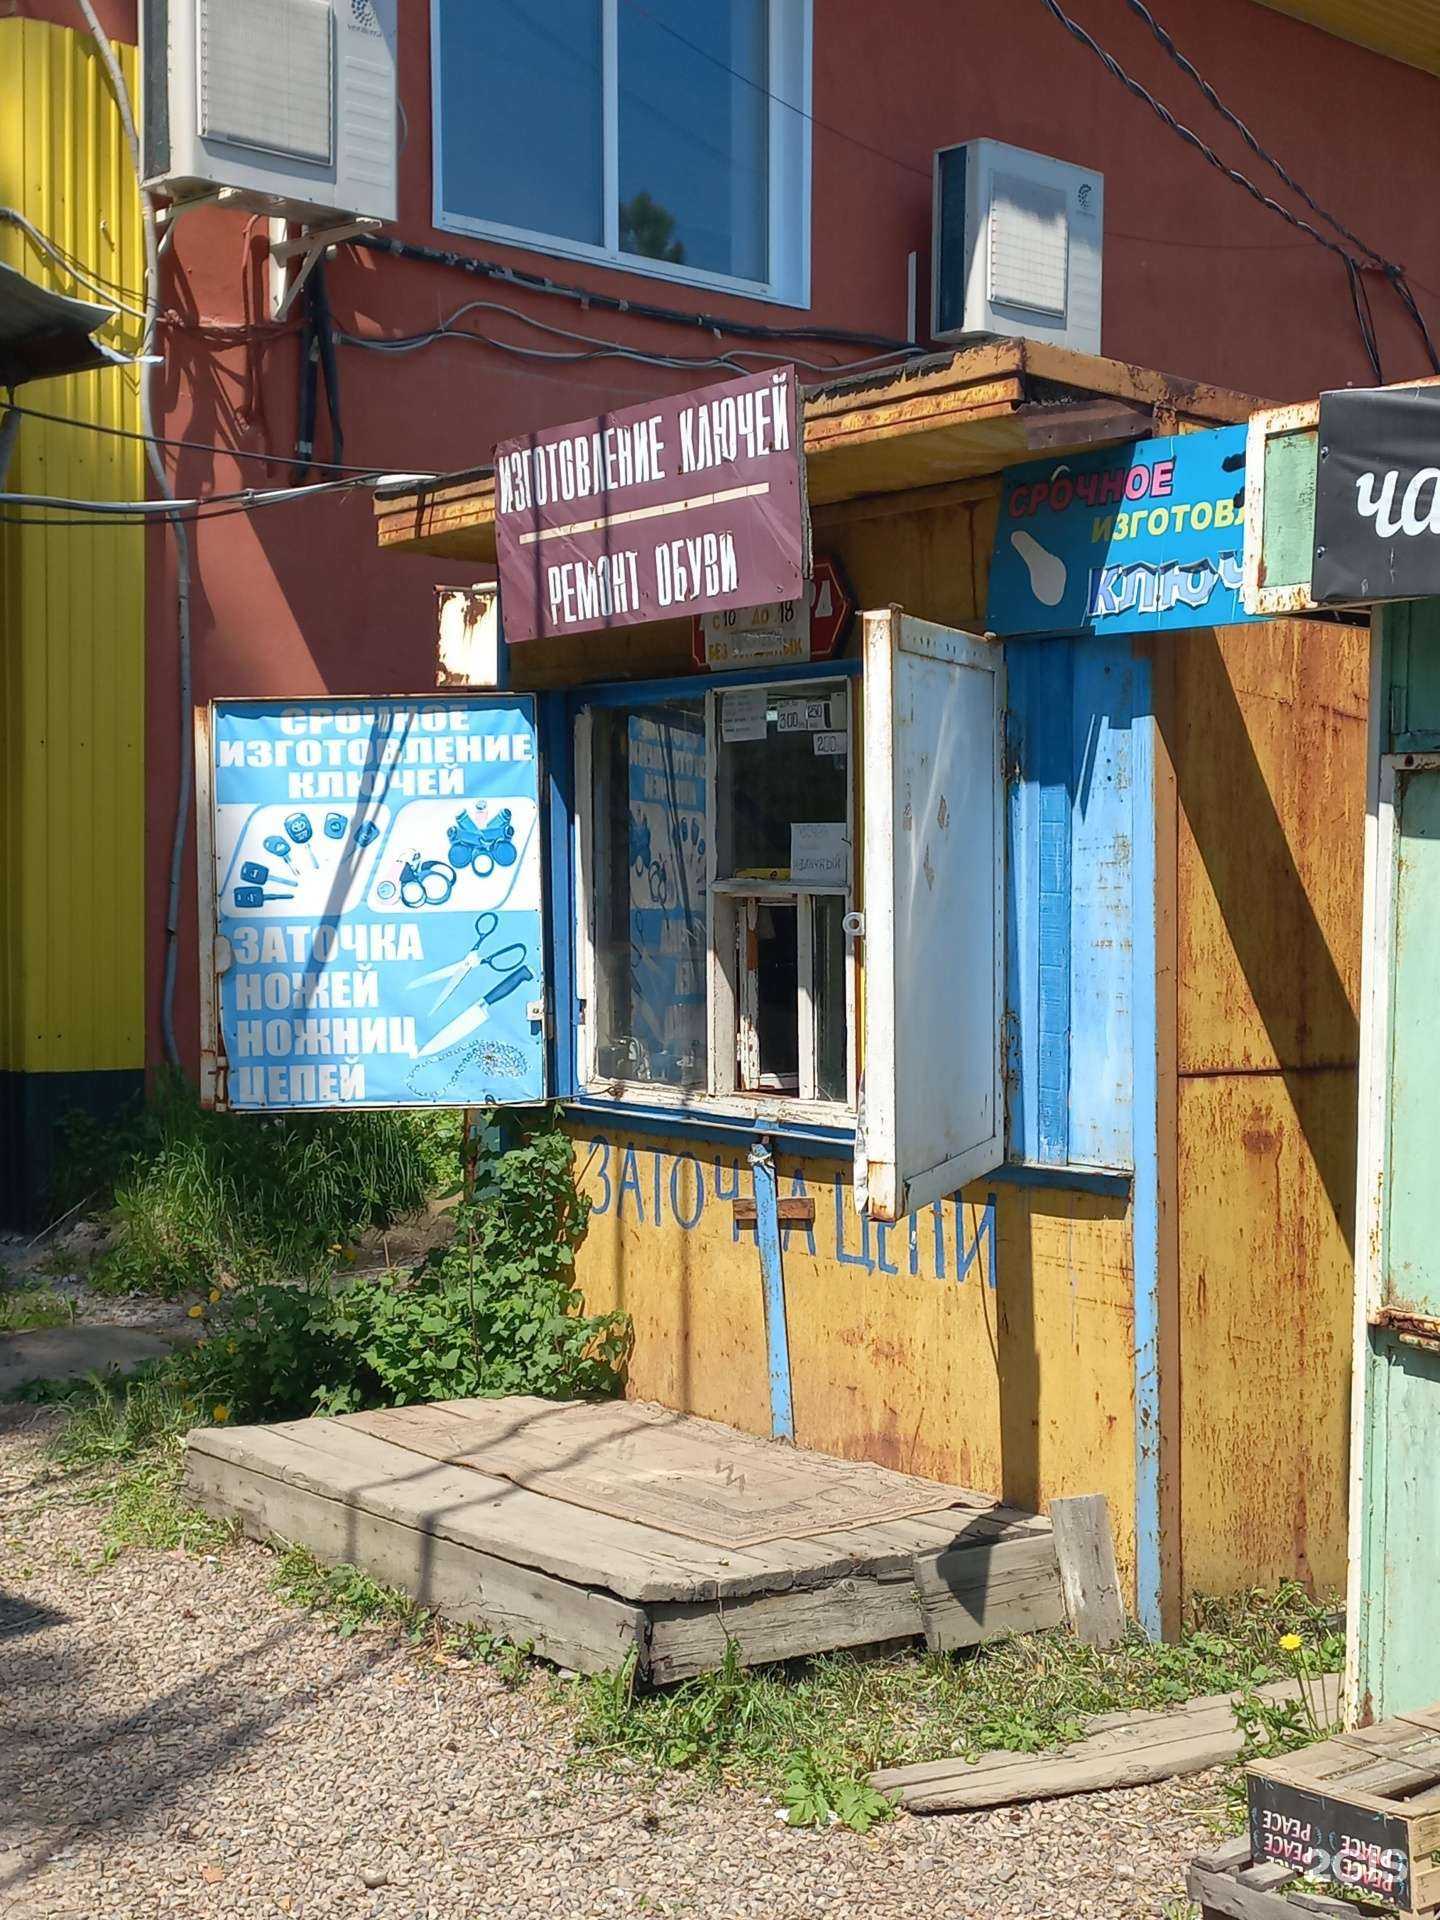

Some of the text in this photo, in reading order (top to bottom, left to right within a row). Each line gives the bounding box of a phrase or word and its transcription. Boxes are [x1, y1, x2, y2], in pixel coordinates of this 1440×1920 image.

[499, 373, 790, 514] ИЗГОТОВЛЕНИЕ КЛЮЧЕЙ
[1009, 459, 1175, 519] СРОЧНОЕ
[547, 551, 640, 626] РЕМОНТ
[655, 531, 738, 608] ОБУВИ
[723, 609, 736, 626] 10
[780, 601, 794, 624] 18
[279, 704, 471, 736] СРОЧНОЕ
[779, 711, 799, 730] 300
[218, 733, 535, 769] ИЗГОТОВЛЕНИЕ
[288, 763, 465, 800] КЛЮЧЕЙ
[233, 923, 425, 965] ЗАТОЧКА
[235, 963, 380, 1012] НОЖЕЙ
[235, 1016, 420, 1060] НОЖНИЦ
[238, 1056, 366, 1105] ЦЕПЕЙ
[587, 1135, 817, 1257] ЗАТОЧА
[1262, 1810, 1312, 1842] PEACE
[1263, 1833, 1314, 1865] PEACE
[1340, 1835, 1393, 1867] PEACE
[1342, 1859, 1394, 1892] PEACE
